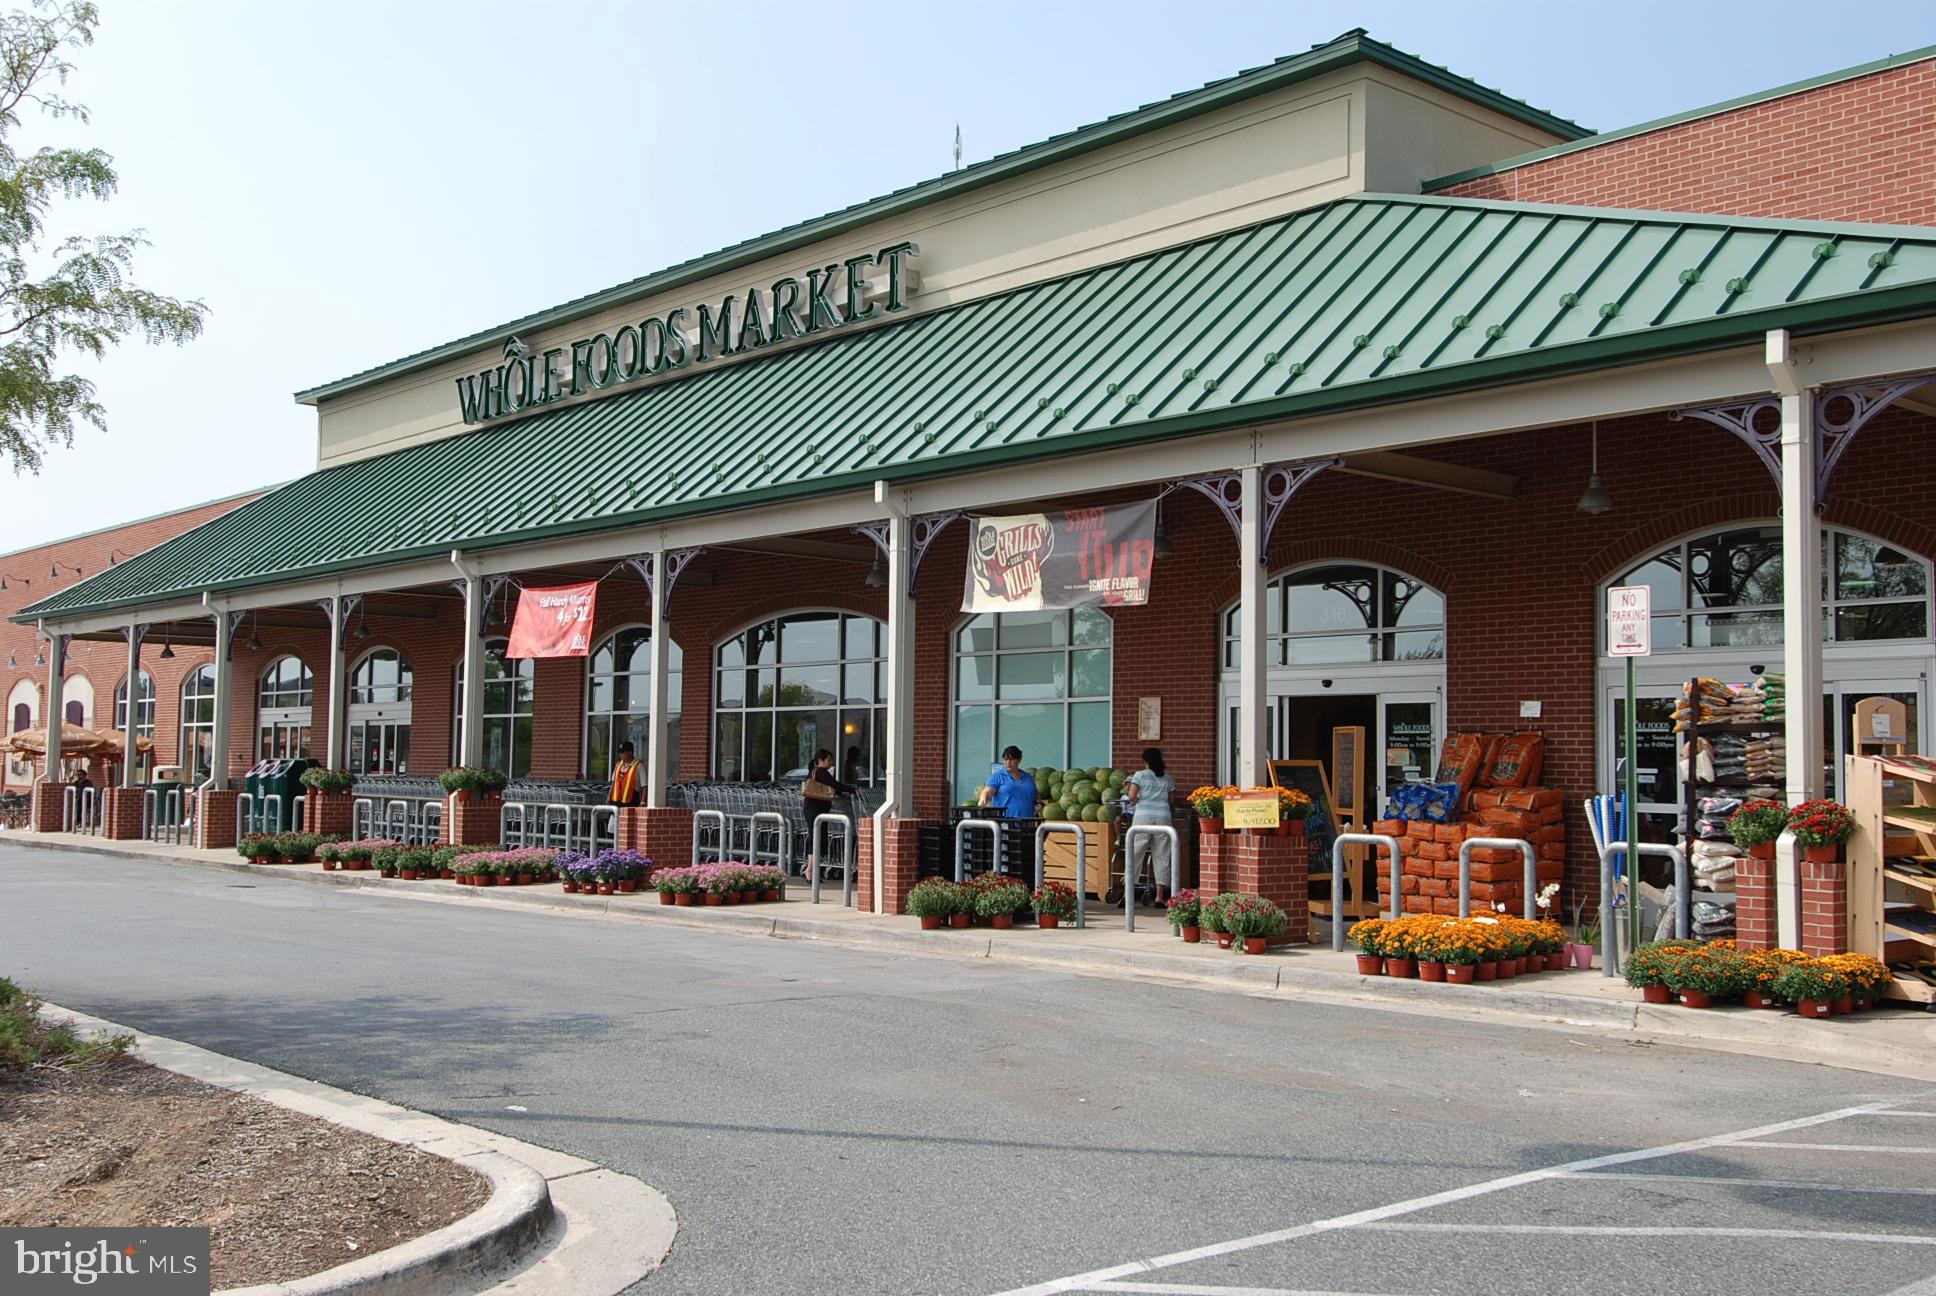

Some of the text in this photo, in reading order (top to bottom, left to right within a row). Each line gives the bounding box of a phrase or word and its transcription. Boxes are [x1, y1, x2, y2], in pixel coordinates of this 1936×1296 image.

[570, 308, 693, 395] FOODS
[696, 242, 920, 362] MARKET
[1065, 507, 1105, 532] START
[998, 526, 1041, 567] GRILLS
[1124, 588, 1145, 602] GRILL!
[1622, 593, 1636, 607] NO
[557, 609, 564, 623] 4
[1612, 609, 1646, 622] PARKING
[1622, 623, 1636, 632] ANY
[1622, 633, 1636, 641] TIME
